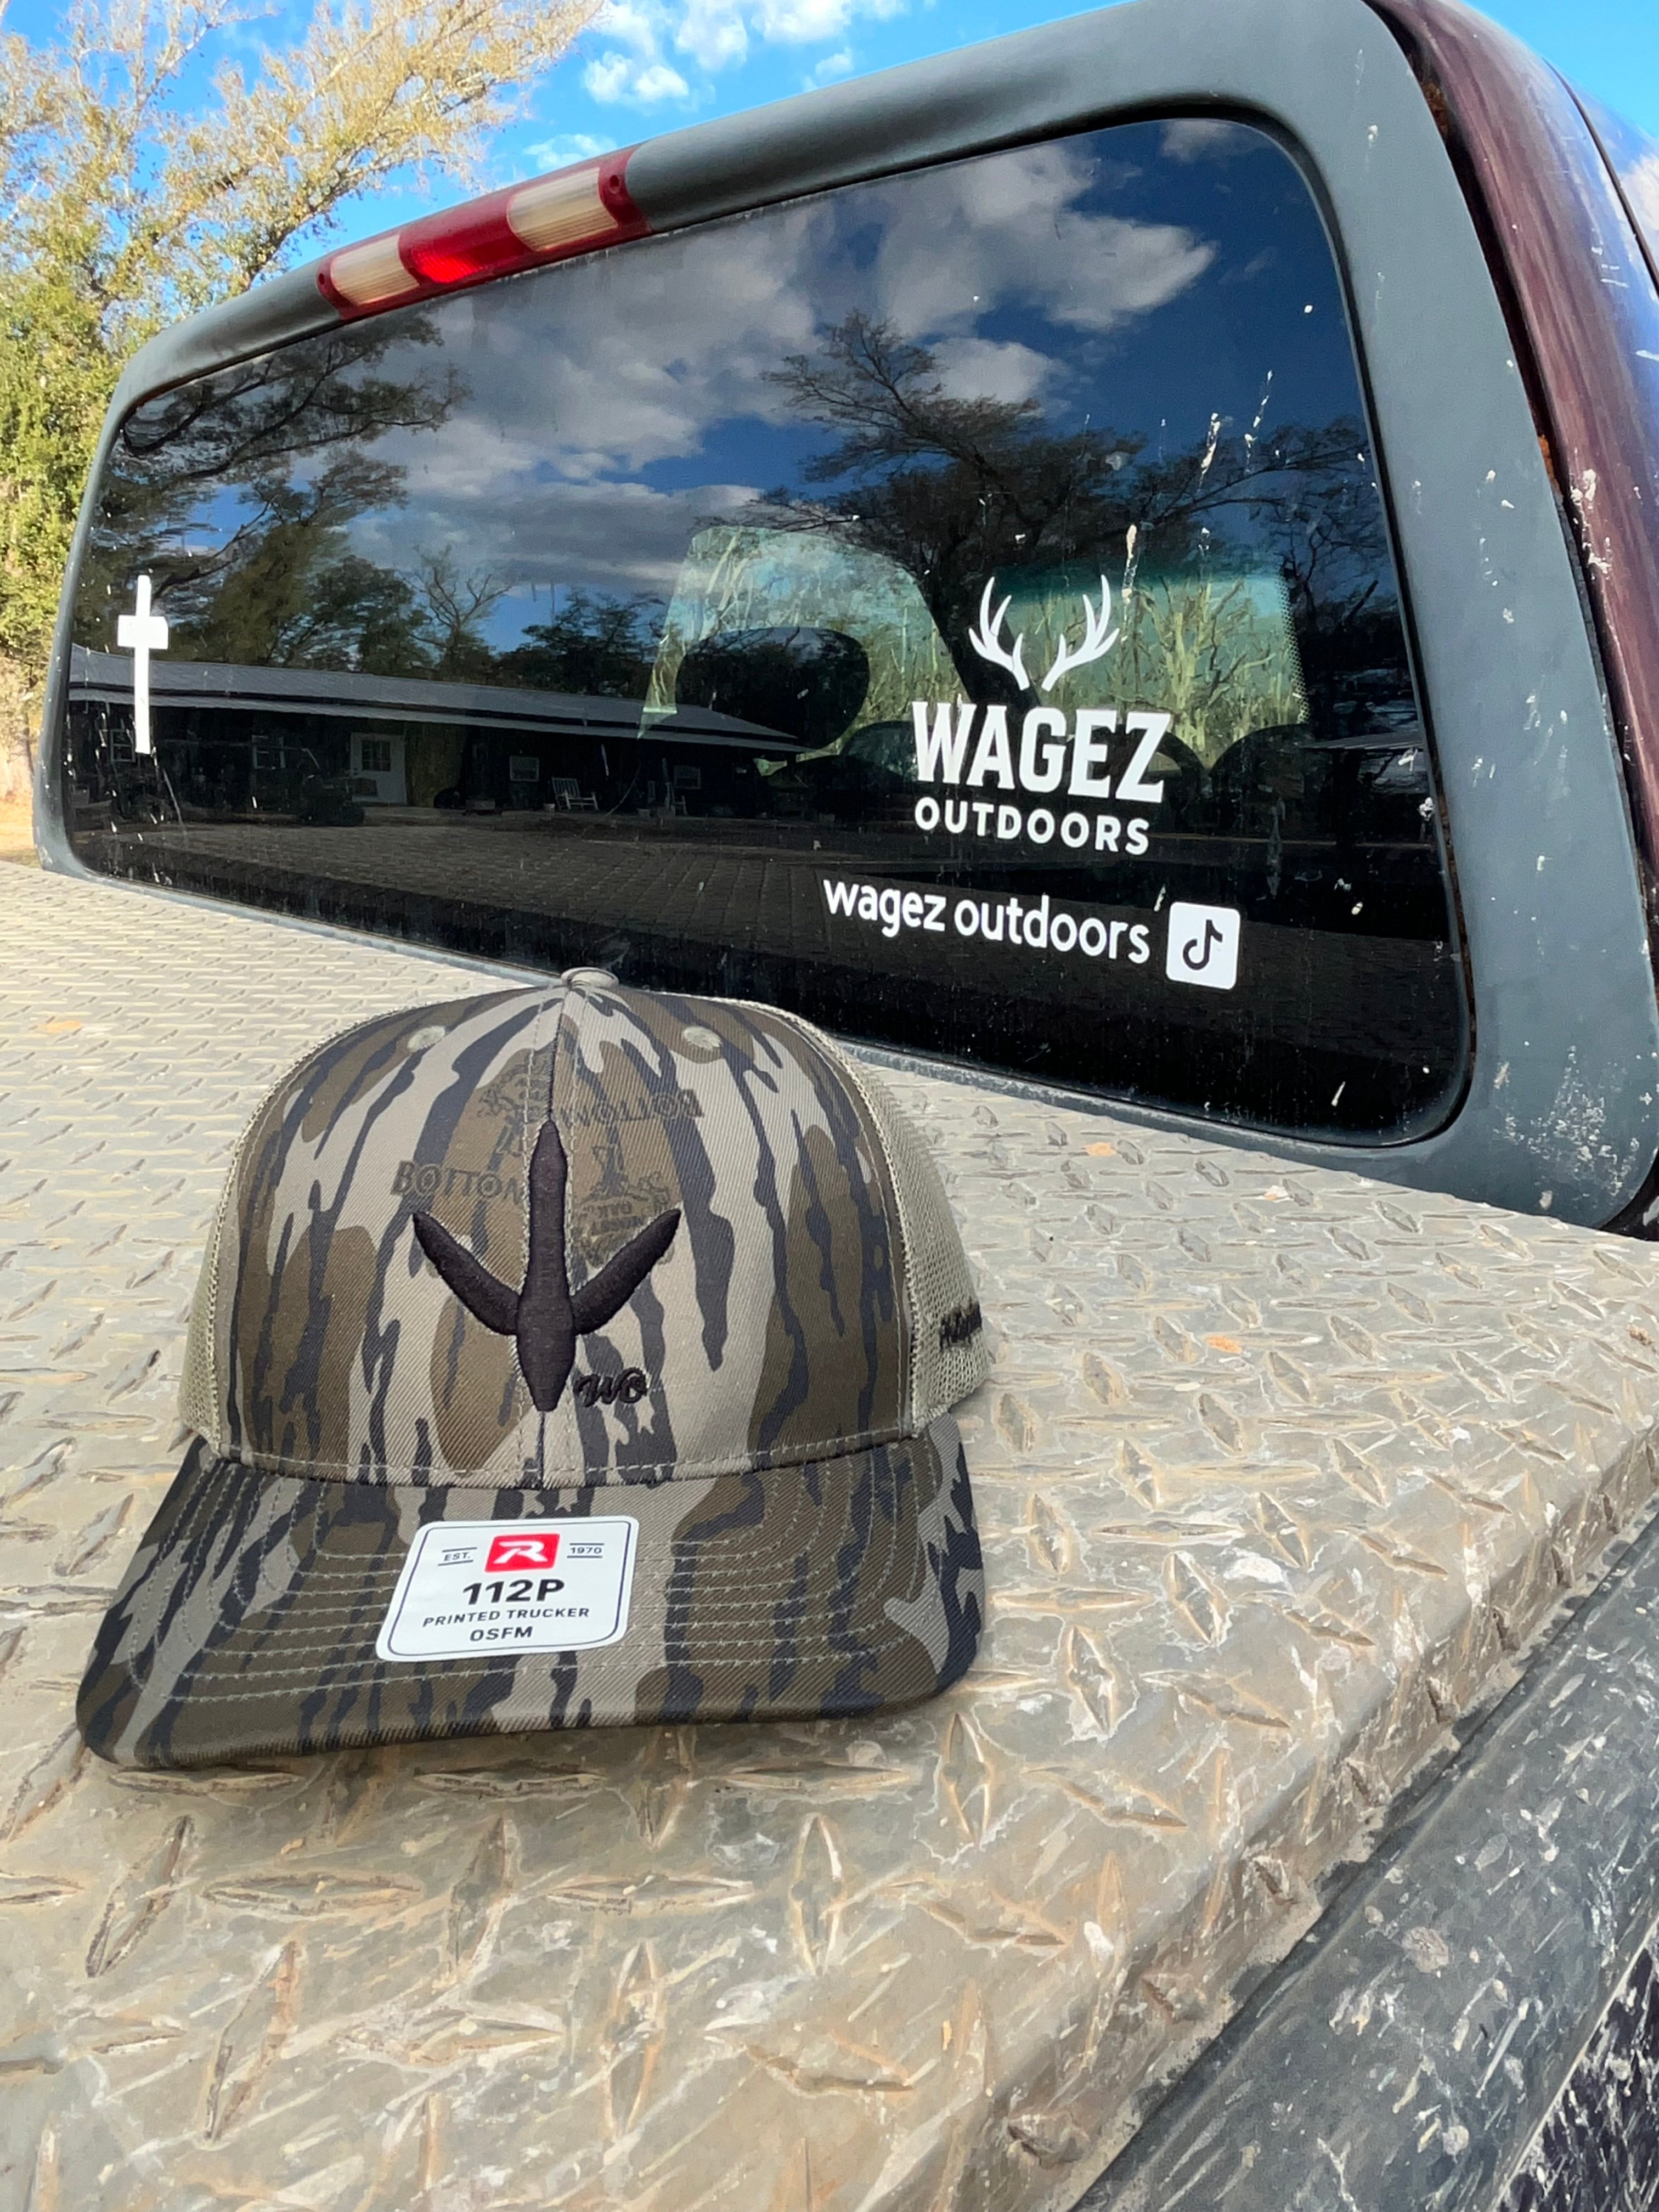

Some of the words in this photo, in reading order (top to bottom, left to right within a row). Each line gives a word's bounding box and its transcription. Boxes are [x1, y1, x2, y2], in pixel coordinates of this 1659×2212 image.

[911, 701, 1172, 804] WAGEZ
[915, 796, 1150, 856] OUTDOORS
[823, 879, 947, 938] wagez
[953, 894, 1150, 964] outdoors
[443, 1551, 471, 1562] EST.
[462, 1578, 565, 1605] 112P
[422, 1610, 501, 1628] PRINTED
[507, 1607, 590, 1620] TRUCKER
[469, 1626, 533, 1642] OSFM
